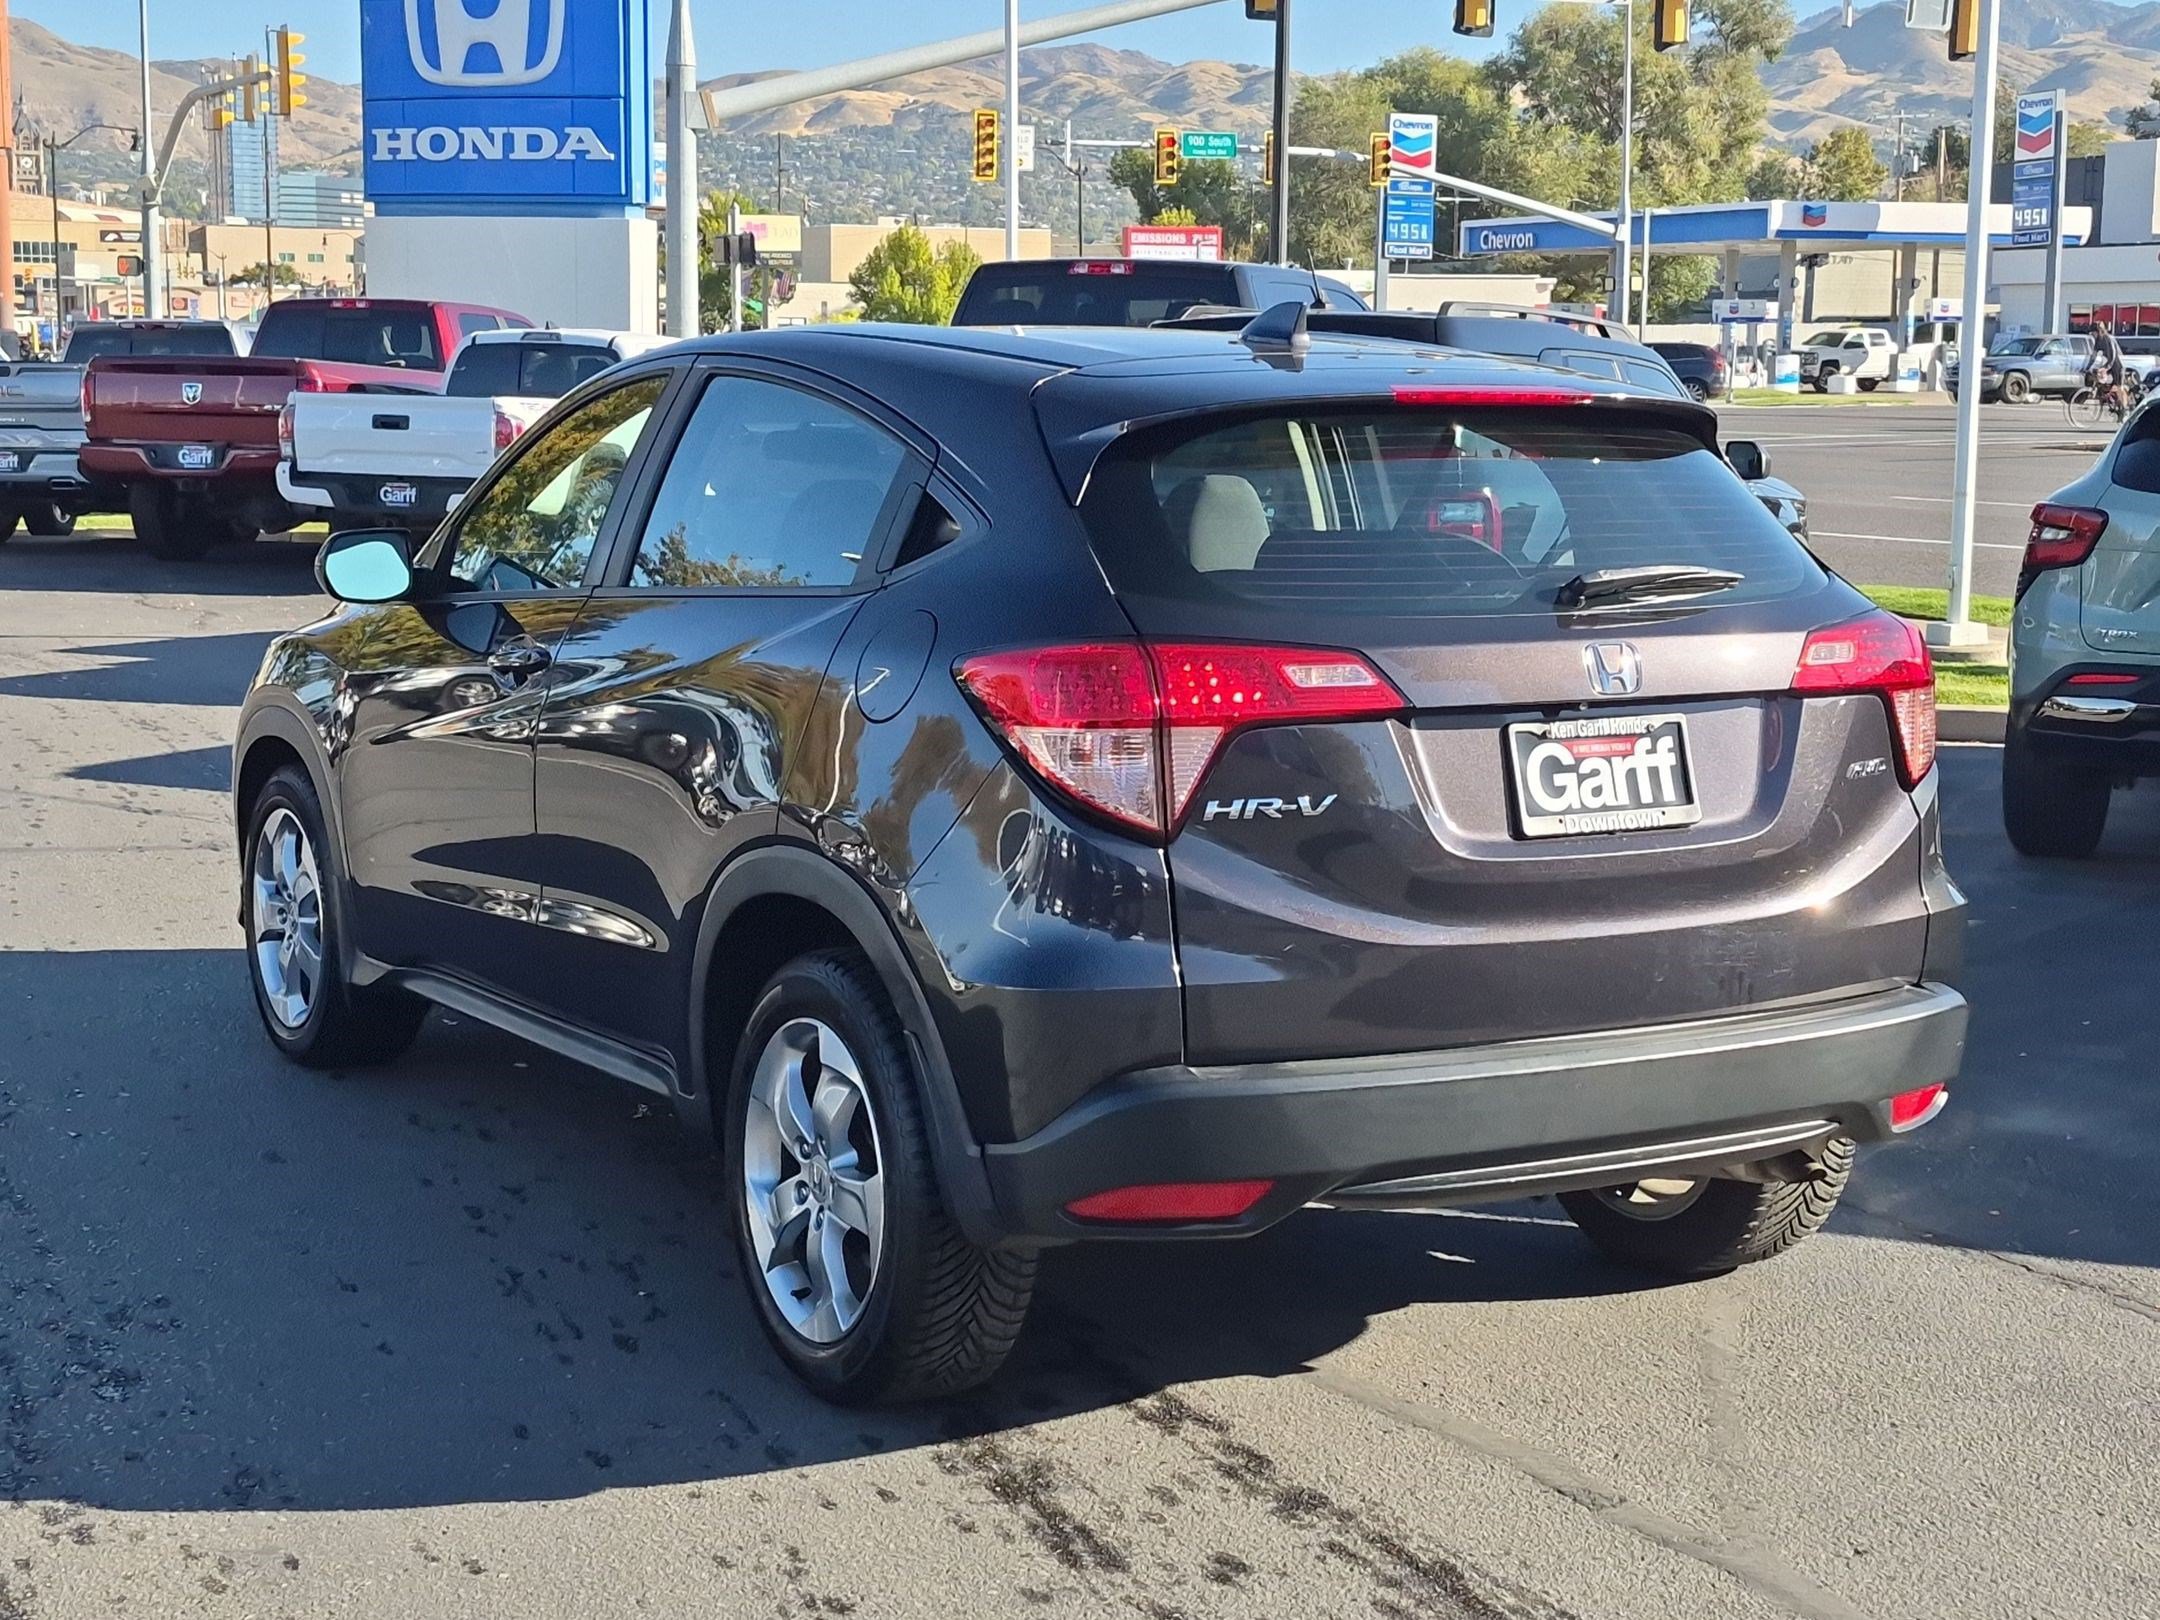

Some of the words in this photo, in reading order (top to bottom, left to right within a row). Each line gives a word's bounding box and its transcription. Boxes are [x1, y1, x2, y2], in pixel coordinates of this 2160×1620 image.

[2019, 98, 2053, 110] Chevron
[1392, 119, 1433, 130] Chevron
[371, 126, 616, 161] HONDA
[1187, 135, 1205, 147] 900
[1208, 135, 1232, 147] South
[1131, 233, 1186, 244] EMISSIONS
[1480, 230, 1534, 250] Chevron
[2031, 232, 2047, 242] Mart
[1389, 246, 1407, 254] Food
[1409, 246, 1428, 255] Mart
[0, 454, 19, 468] arff
[178, 448, 213, 465] Garff
[380, 486, 417, 503] Garff
[1550, 720, 1575, 739] Ken
[1526, 735, 1677, 812] Garff
[1203, 793, 1338, 821] HR-V
[1563, 810, 1664, 834] Downtown
